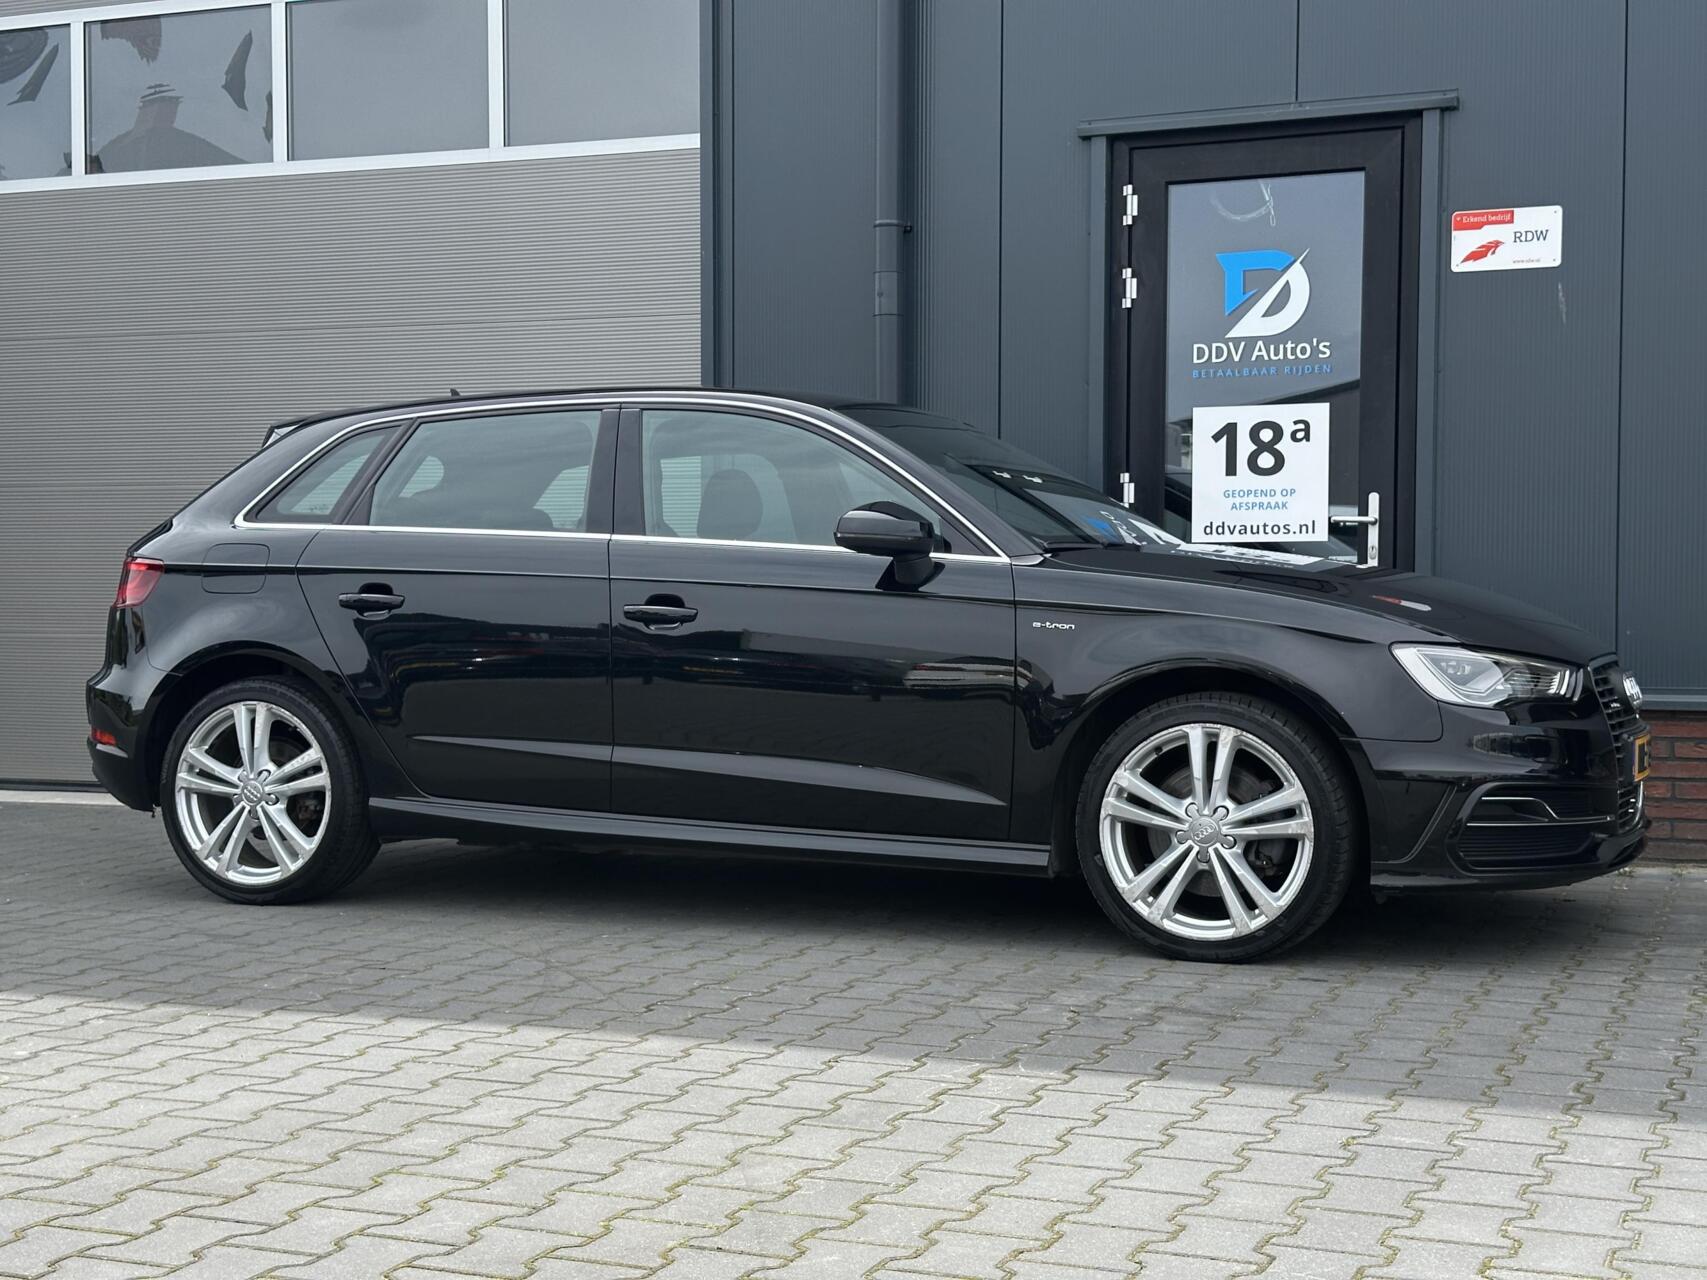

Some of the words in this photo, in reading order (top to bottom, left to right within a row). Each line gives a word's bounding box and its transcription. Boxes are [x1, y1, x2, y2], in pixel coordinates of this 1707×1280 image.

[1513, 229, 1549, 243] RDW
[1192, 341, 1245, 364] DDV
[1251, 338, 1331, 361] Auto's
[1192, 366, 1278, 378] BETAALBAAR
[1284, 364, 1332, 377] RIJDEN
[1223, 489, 1276, 498] GEOPEND
[1280, 488, 1296, 497] OP
[1230, 501, 1289, 511] AFSPRAAK
[1203, 520, 1316, 536] ddvautos.nl
[1032, 621, 1075, 630] e-tron
